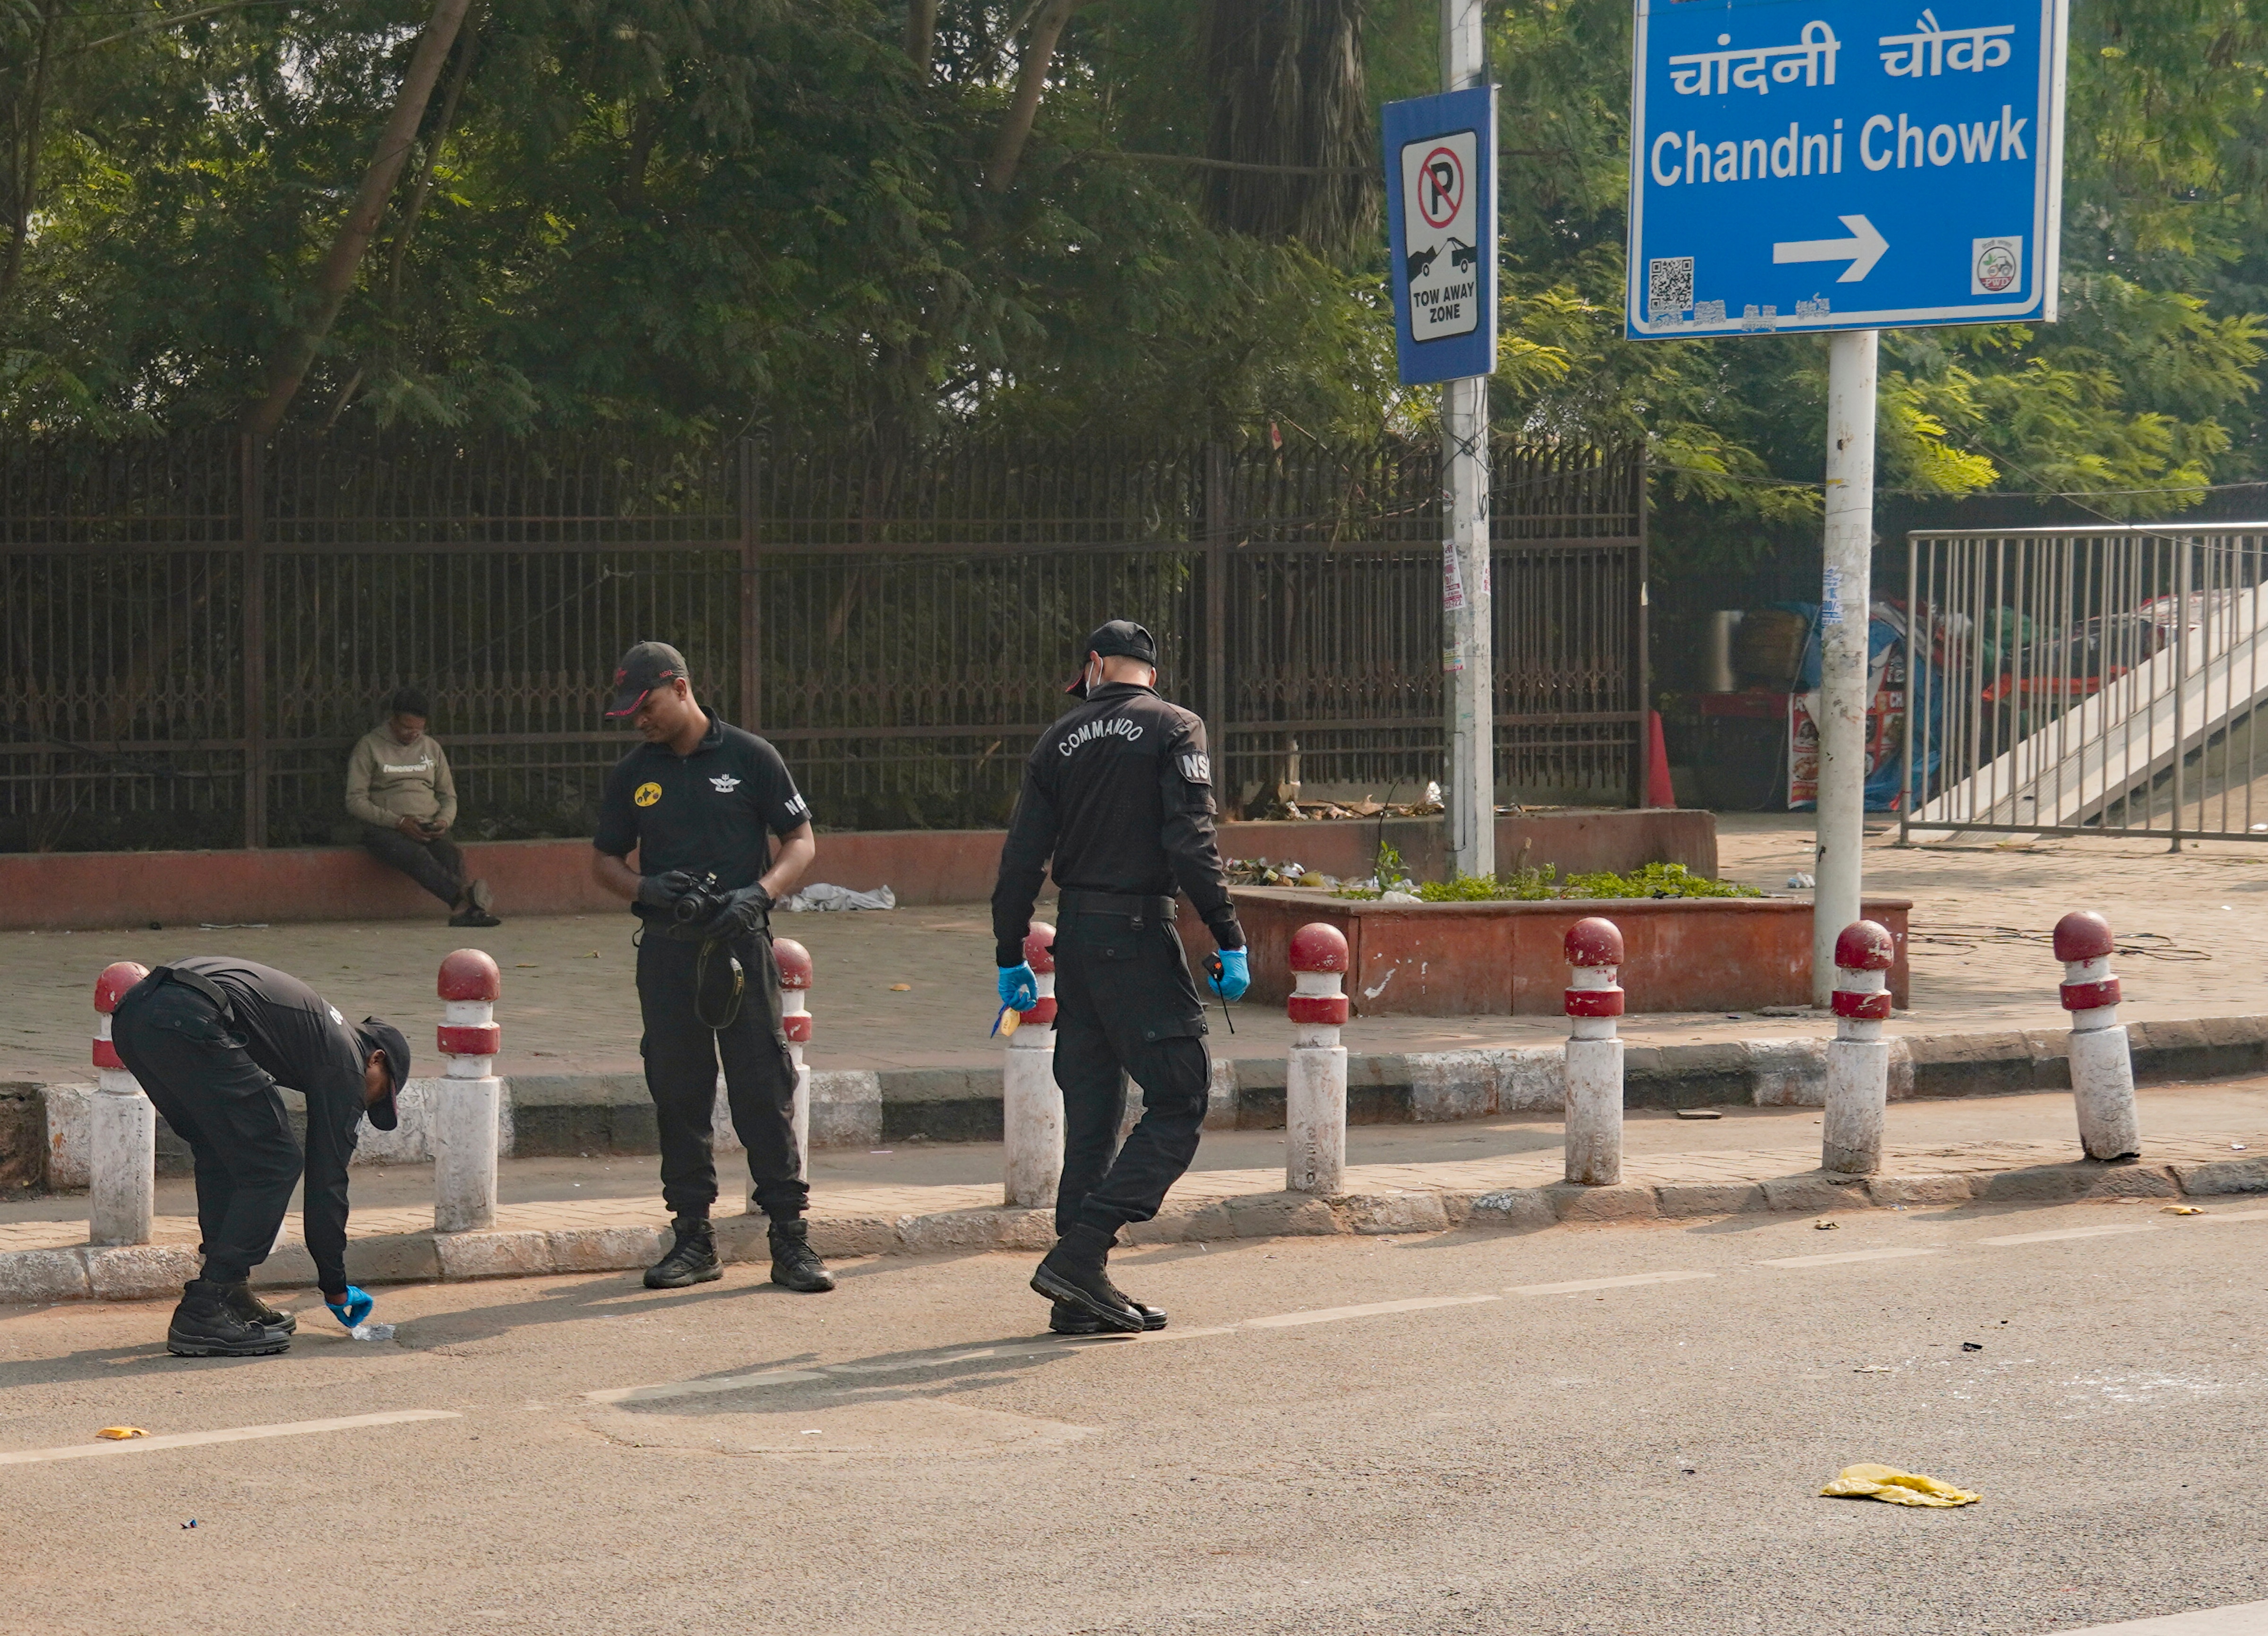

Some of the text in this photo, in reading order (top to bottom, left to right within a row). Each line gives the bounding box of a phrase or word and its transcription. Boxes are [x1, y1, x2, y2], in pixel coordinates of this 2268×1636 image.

[1669, 9, 2015, 95] चांदनी चौक
[1651, 104, 2027, 186] Chandni Chowk
[1413, 281, 1474, 308] TOW AWAY
[1985, 278, 2008, 286] PWD
[1429, 303, 1460, 324] ZONE
[1058, 717, 1143, 757] COMMANDO
[1182, 754, 1210, 780] NS
